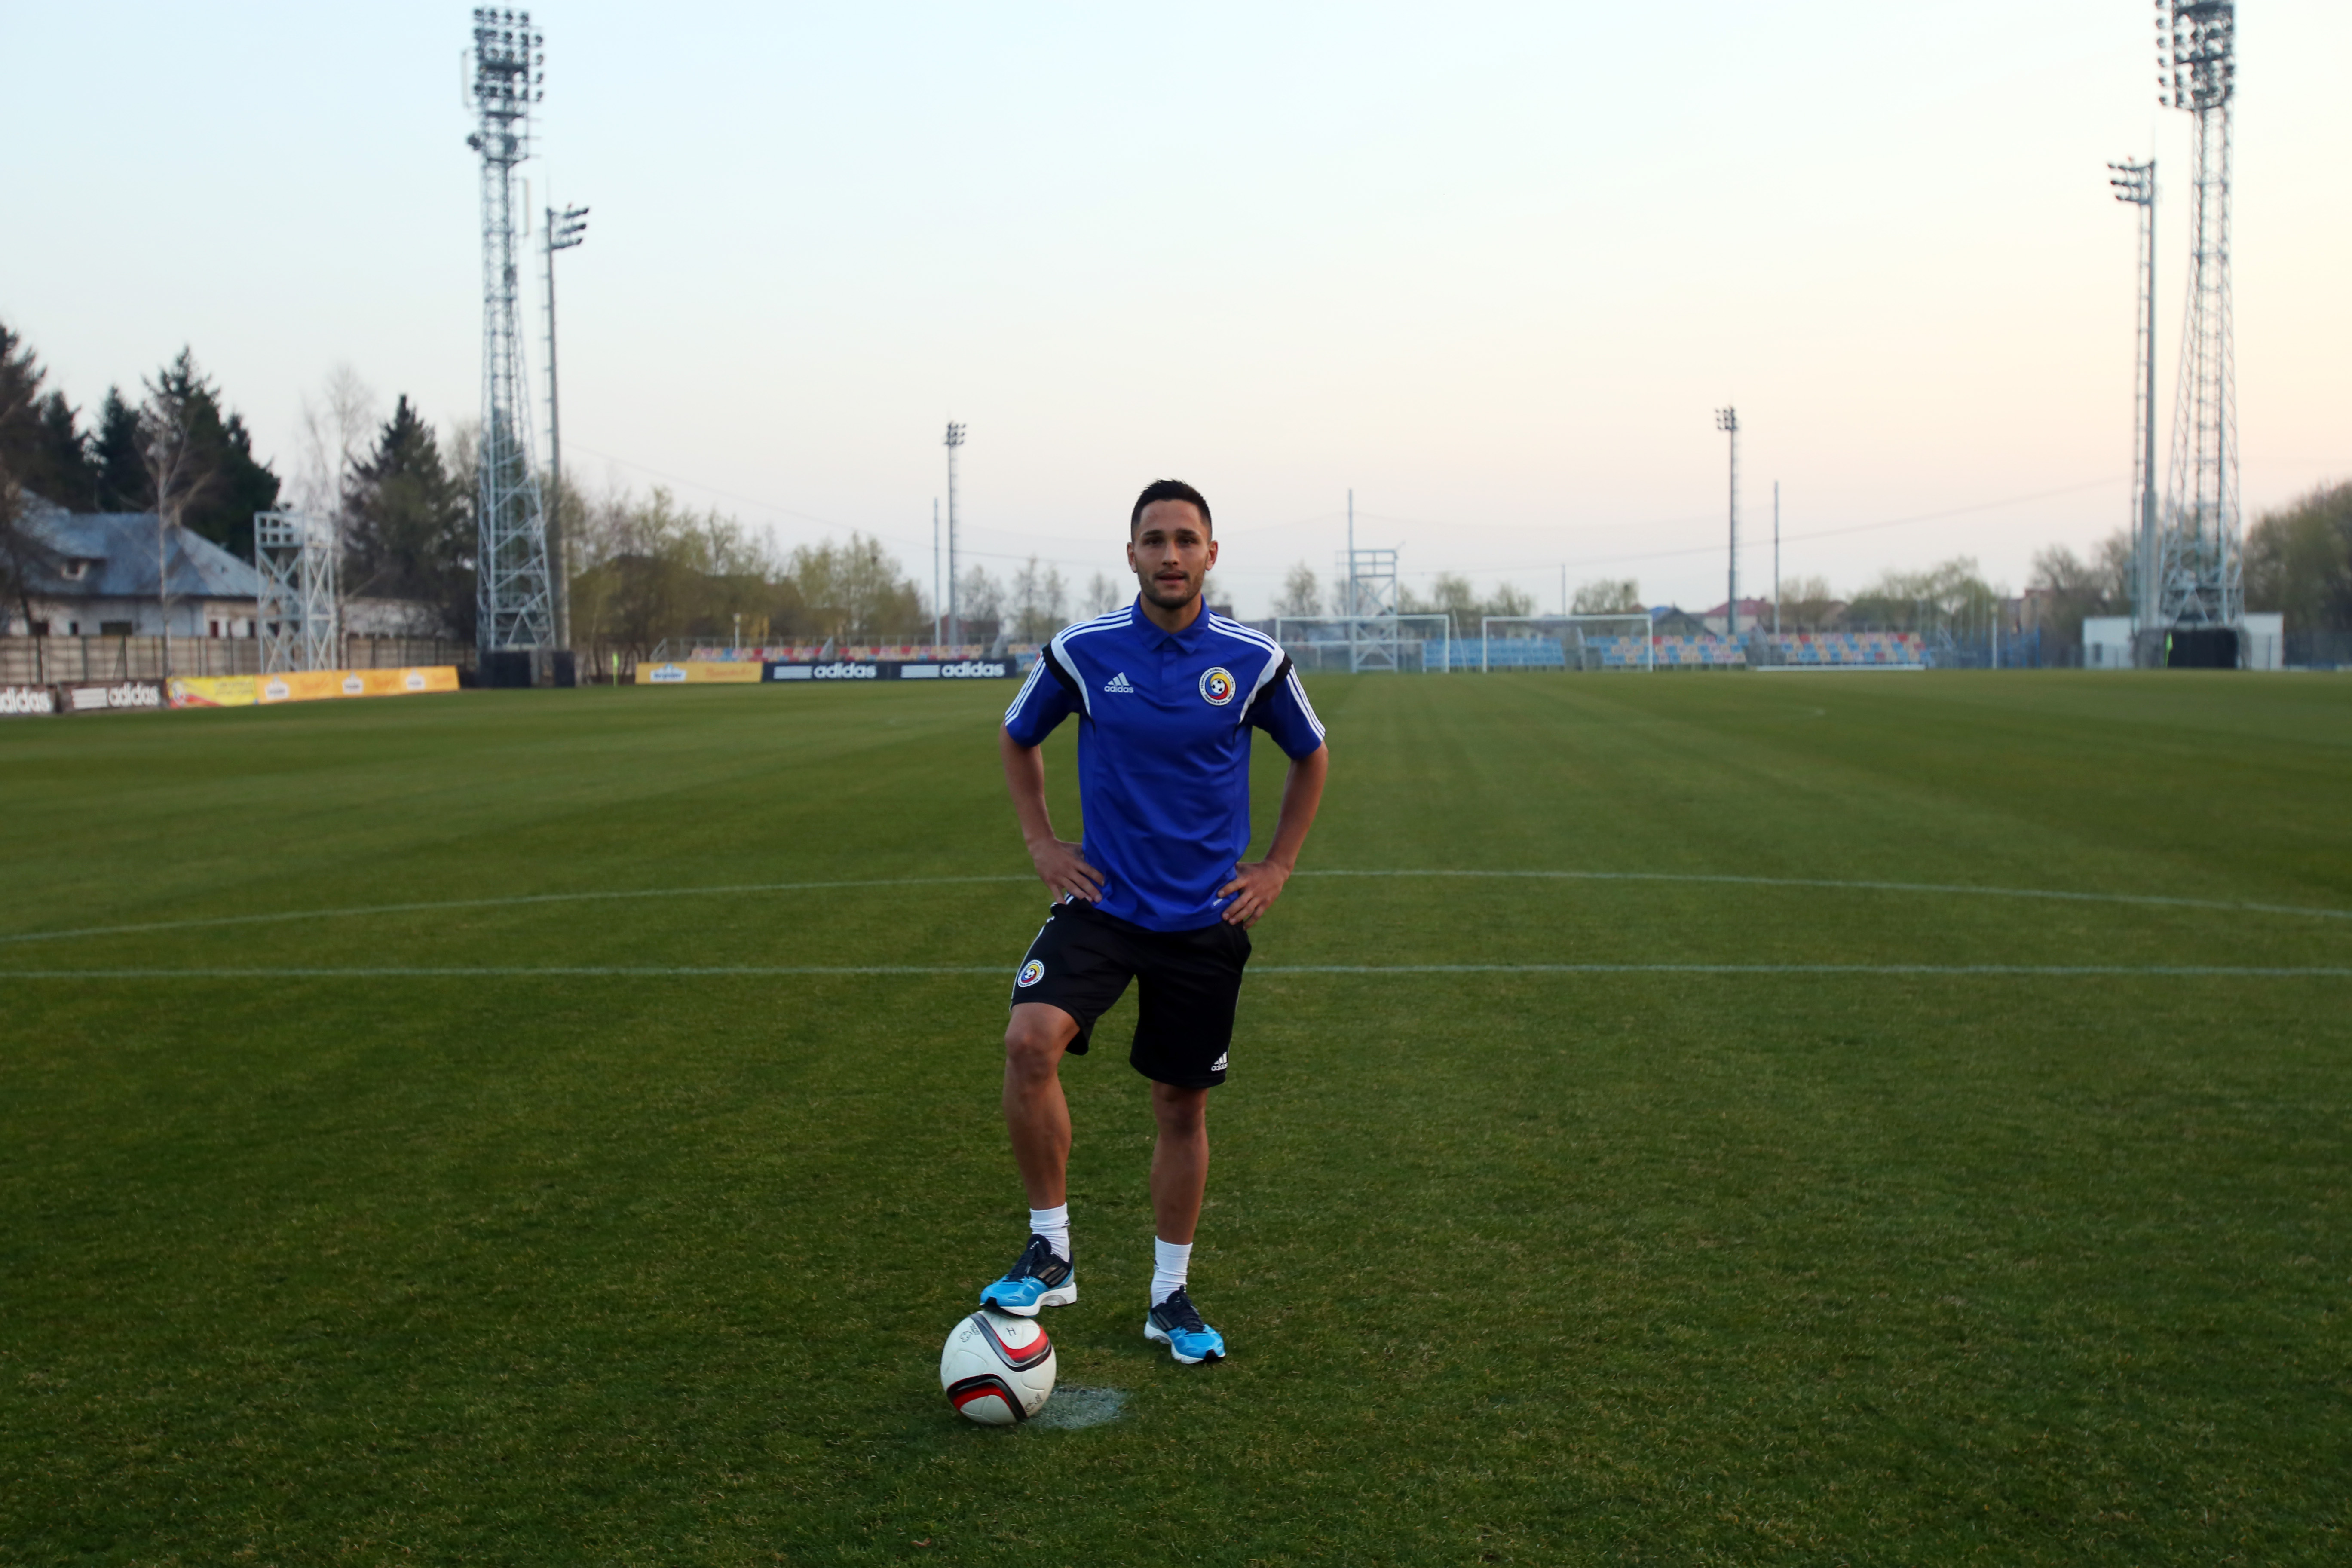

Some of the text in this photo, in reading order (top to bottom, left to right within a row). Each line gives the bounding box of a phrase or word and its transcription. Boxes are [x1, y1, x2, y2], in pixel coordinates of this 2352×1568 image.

[814, 662, 877, 679] adidas
[941, 661, 1005, 678] adidas
[108, 682, 159, 707] adidas
[1104, 685, 1134, 693] adidas
[0, 686, 52, 713] didas
